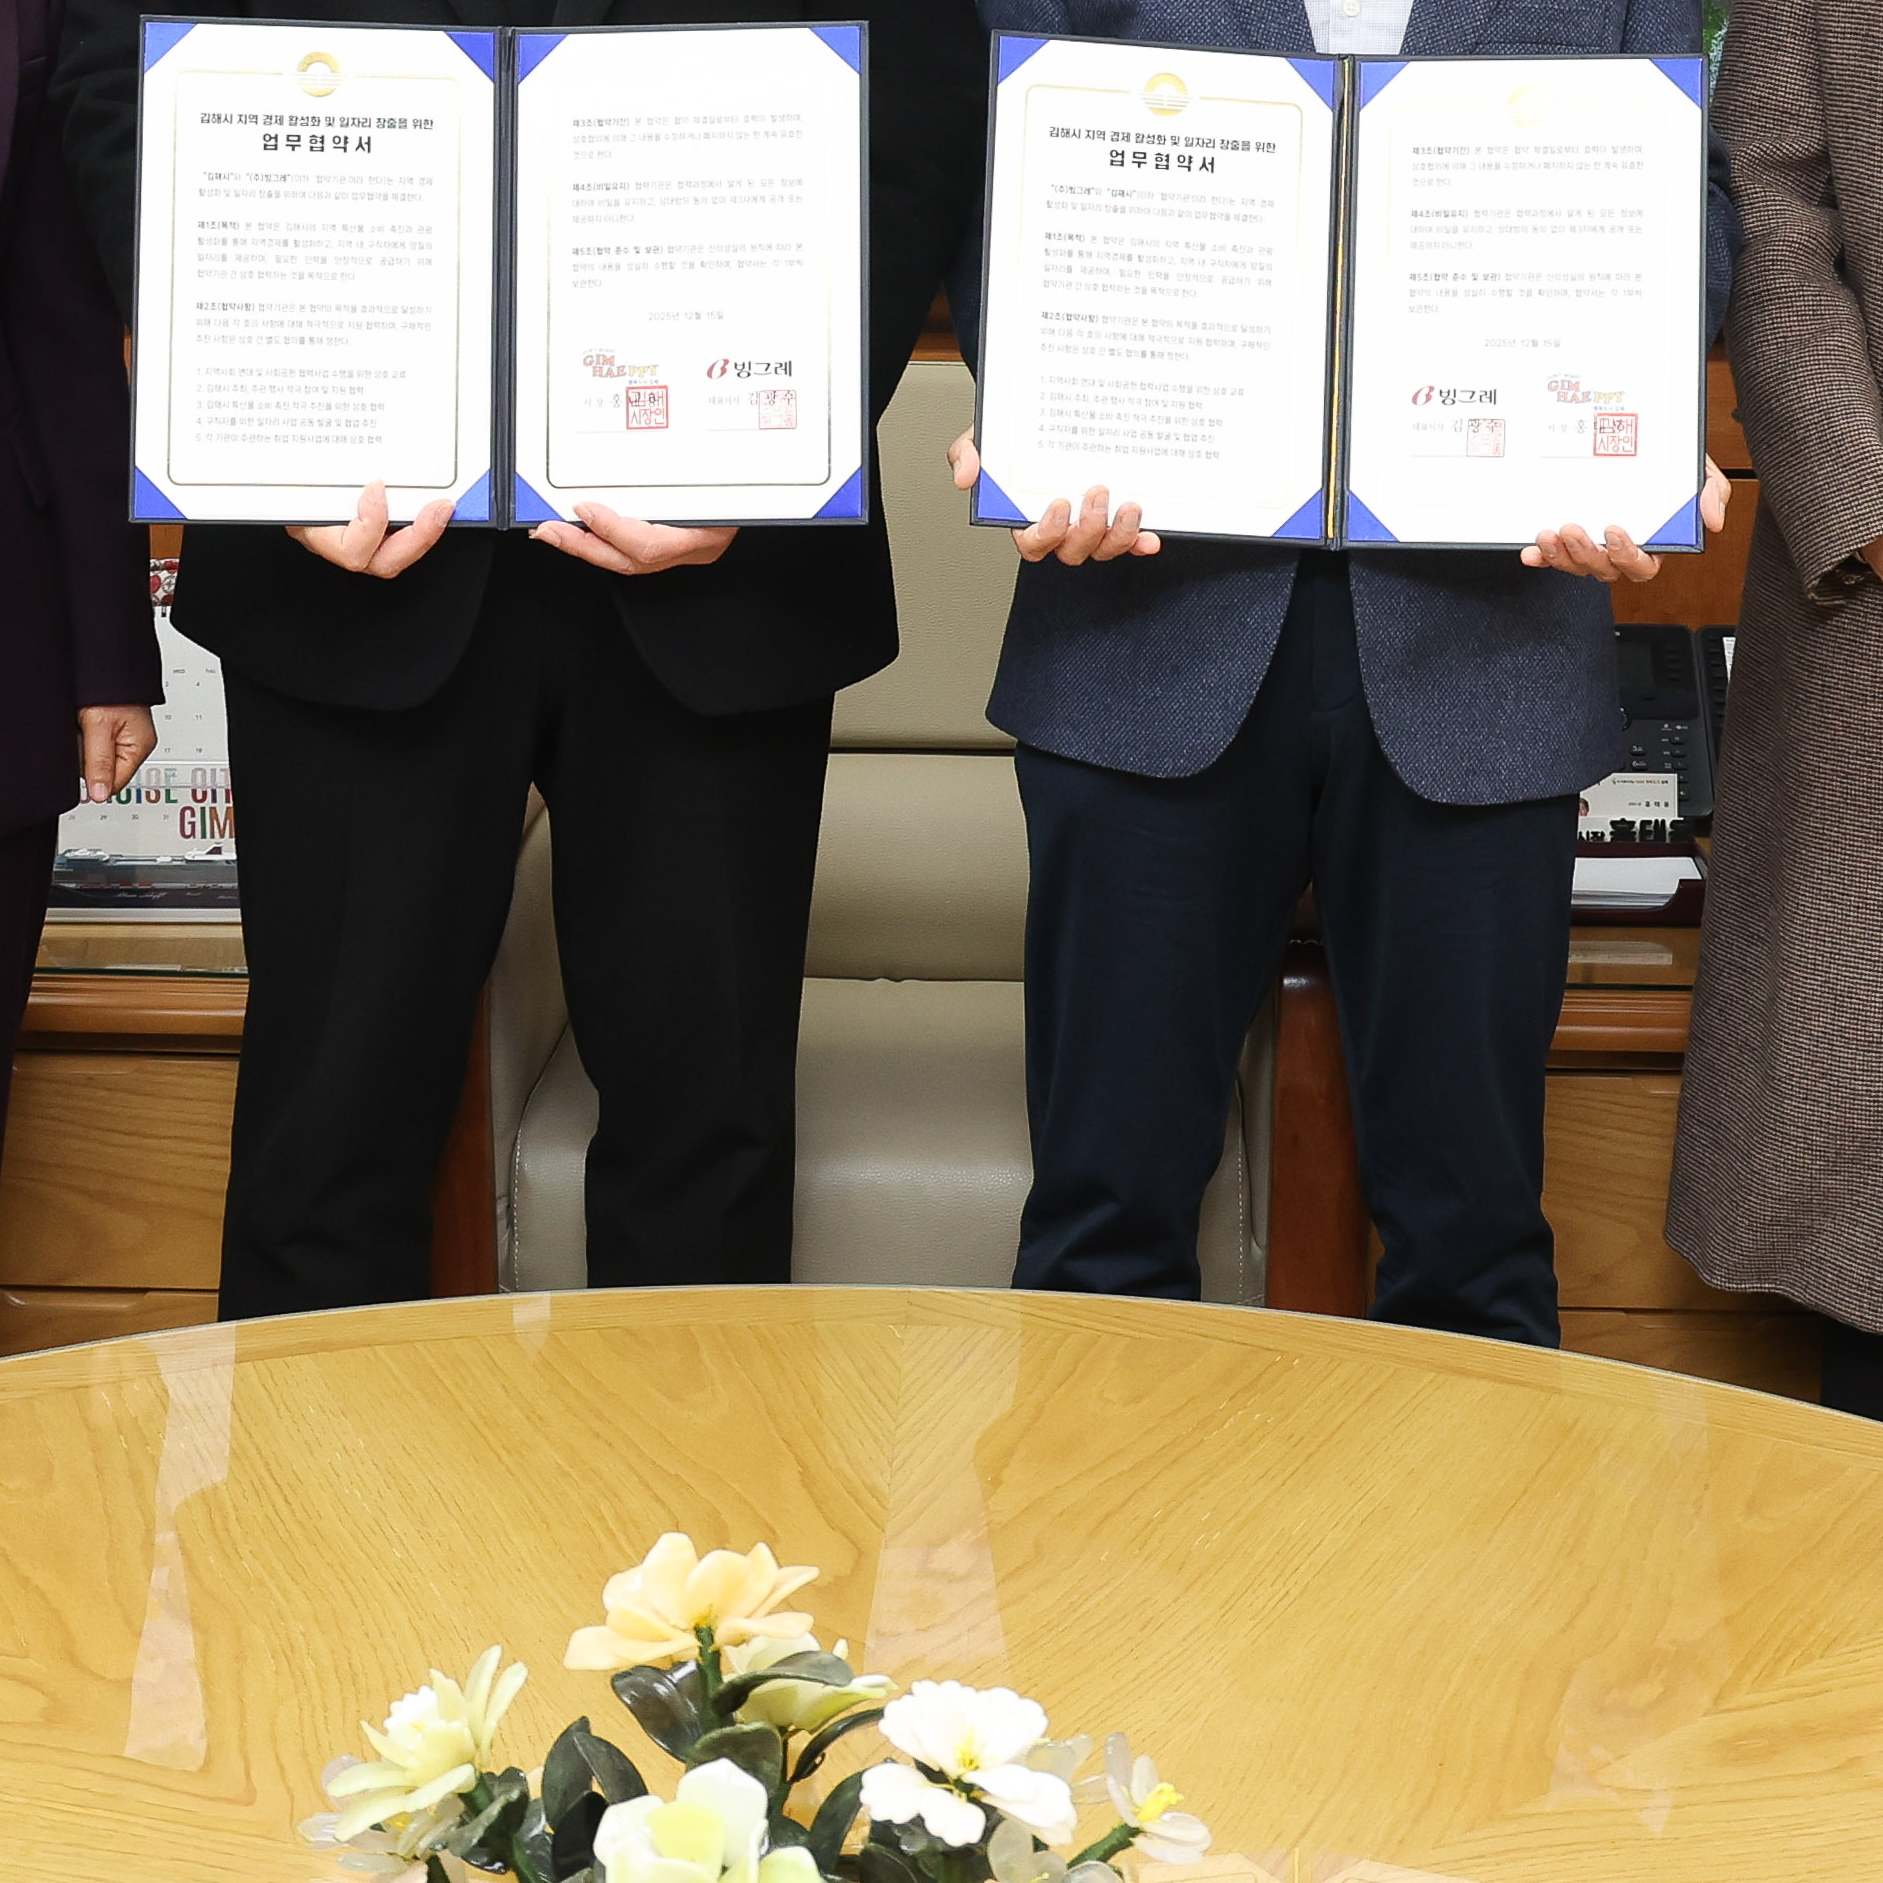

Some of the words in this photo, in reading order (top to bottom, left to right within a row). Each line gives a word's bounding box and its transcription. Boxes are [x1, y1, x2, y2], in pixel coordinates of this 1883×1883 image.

[201, 113, 233, 124] 김해시
[237, 114, 258, 125] 지역
[263, 115, 284, 126] 경제
[288, 115, 321, 127] 활성화
[325, 116, 335, 127] 및
[339, 117, 372, 128] 일자리
[412, 119, 434, 130] 위한
[263, 133, 371, 154] 업무협약서
[1050, 126, 1081, 139] 김해시
[1085, 129, 1106, 141] 지역
[1110, 131, 1131, 142] 경제
[1134, 133, 1166, 145] 활성화
[1170, 136, 1180, 146] 및
[1184, 137, 1216, 149] 일자리
[1255, 142, 1276, 154] 위한
[1110, 149, 1215, 174] 업무협약서
[734, 360, 792, 379] 빙그레
[1439, 388, 1497, 405] 빙그레
